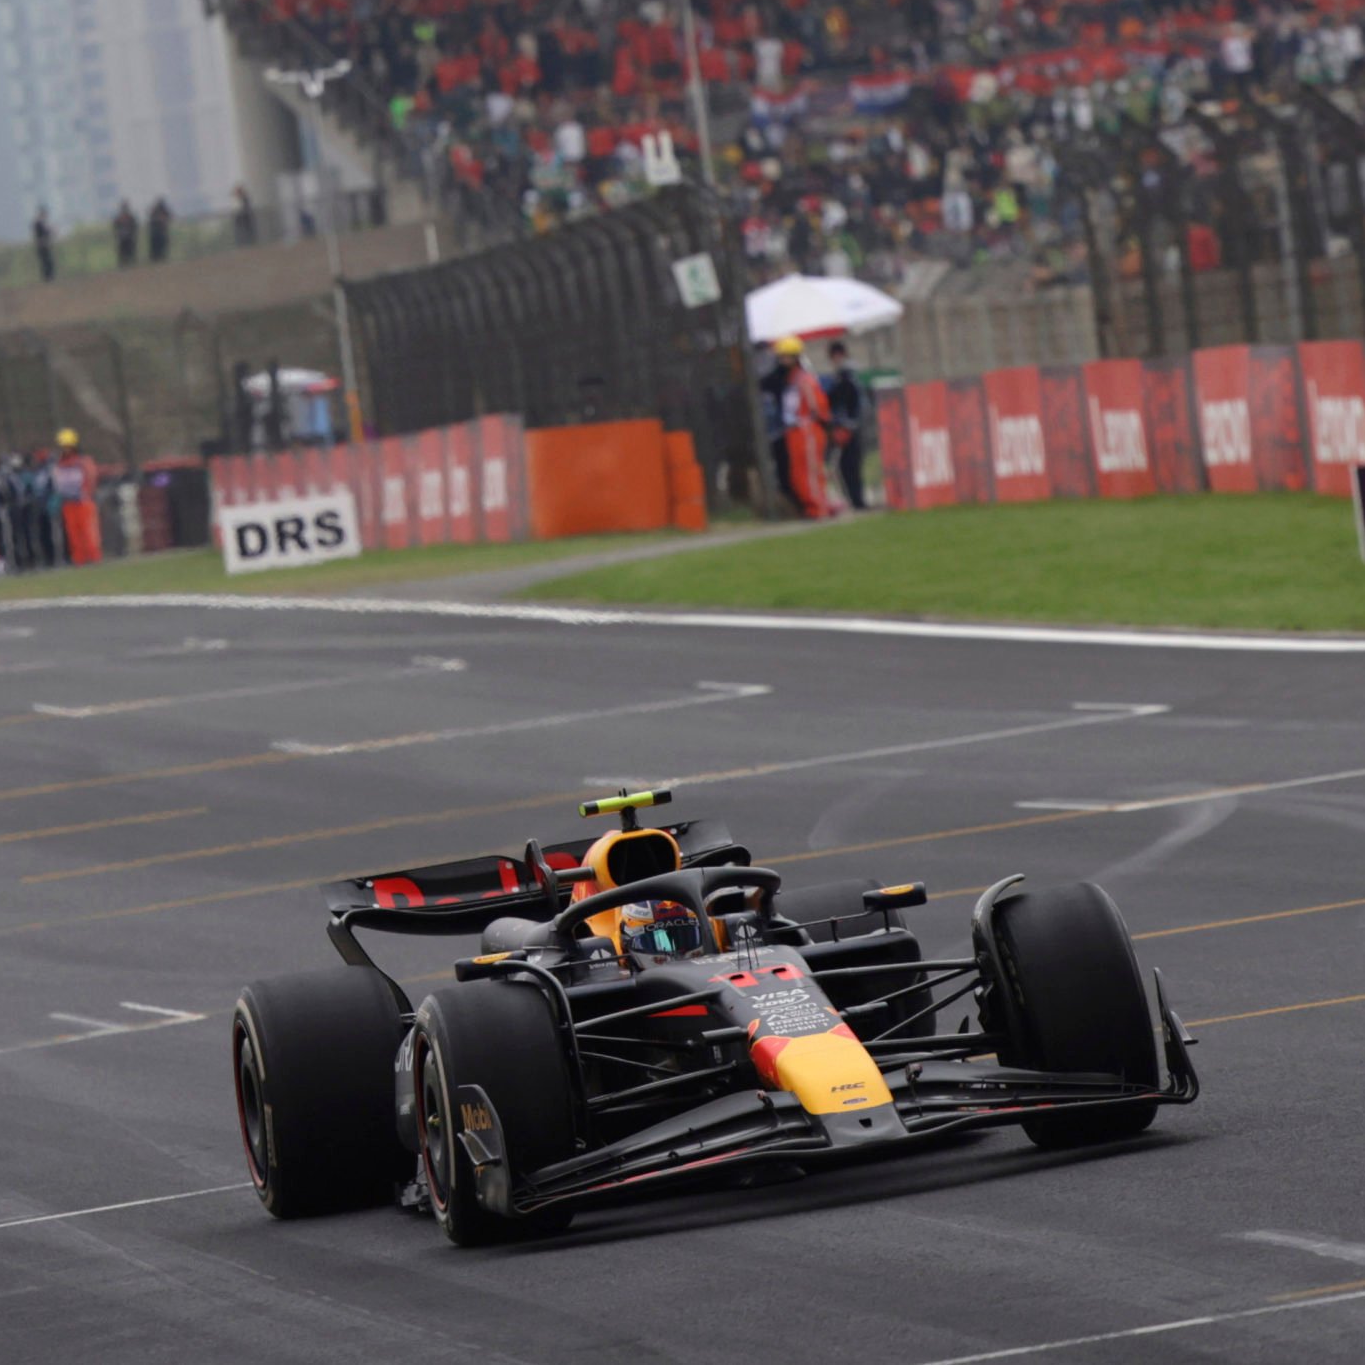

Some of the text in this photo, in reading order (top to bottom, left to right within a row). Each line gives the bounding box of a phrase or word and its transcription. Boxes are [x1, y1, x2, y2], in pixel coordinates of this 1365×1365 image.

[235, 511, 345, 558] DRS
[373, 858, 520, 909] Rd
[751, 988, 806, 1001] VISA
